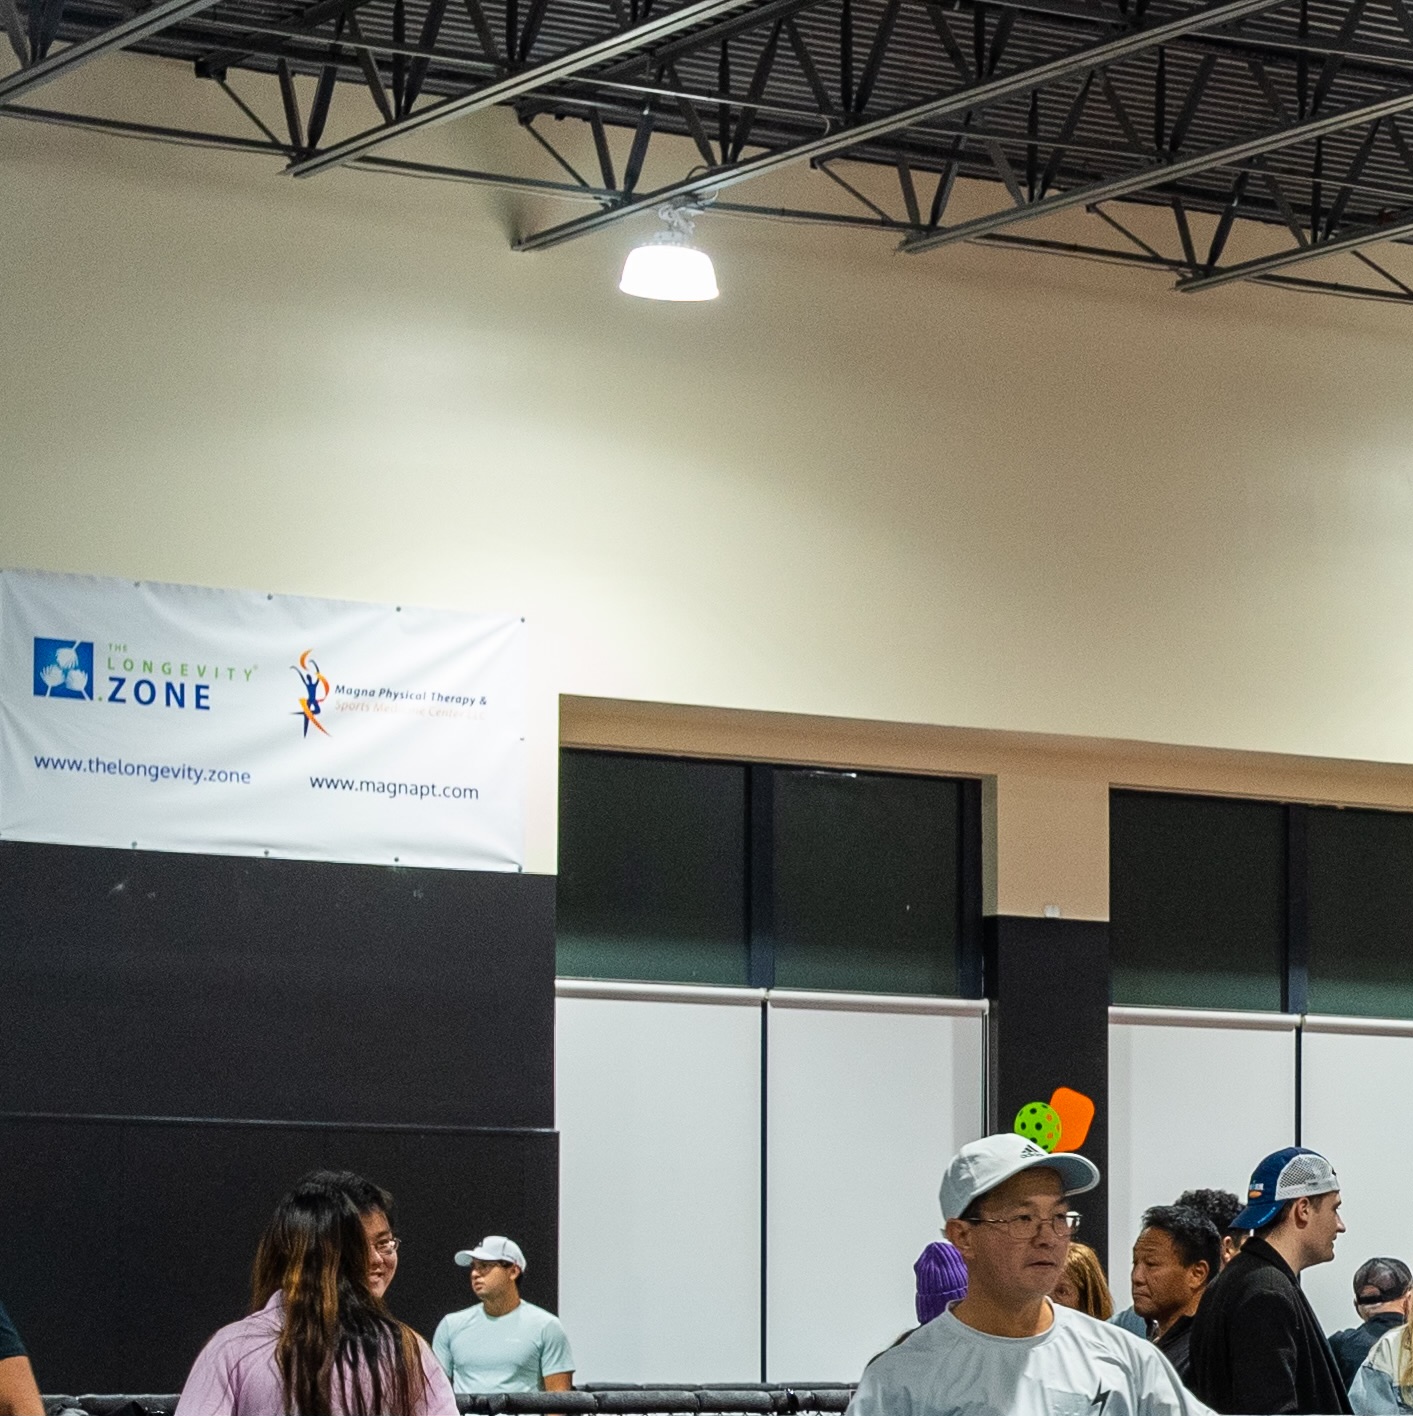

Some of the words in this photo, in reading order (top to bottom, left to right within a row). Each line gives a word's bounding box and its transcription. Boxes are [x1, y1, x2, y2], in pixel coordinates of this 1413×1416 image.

[108, 643, 128, 652] THE
[334, 684, 375, 698] Magna
[378, 687, 426, 700] Physical
[430, 691, 475, 706] Therapy
[479, 696, 488, 705] &
[33, 753, 251, 785] www.thelongevity.zone
[309, 775, 480, 800] www.magnapt.com
